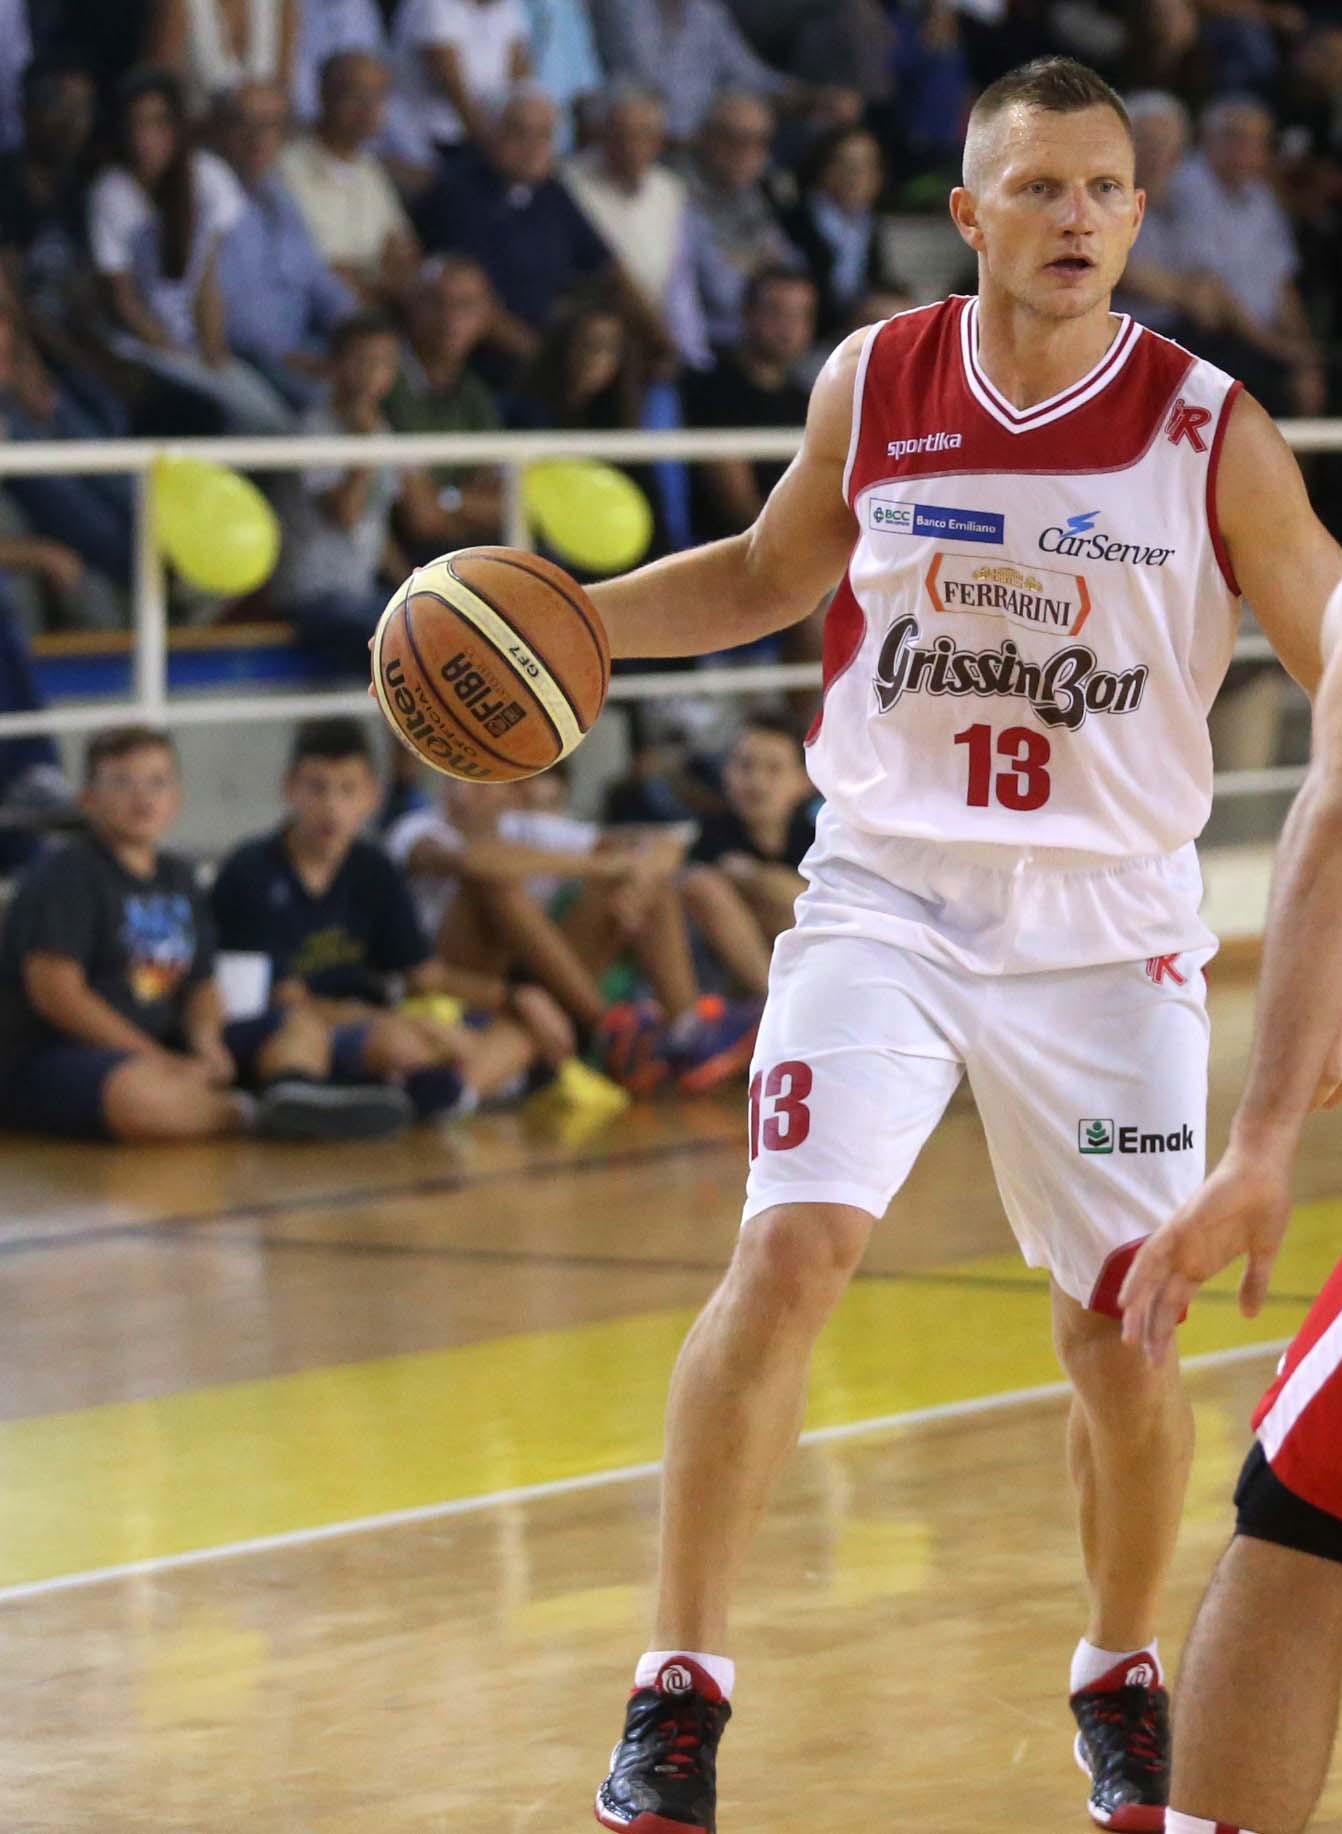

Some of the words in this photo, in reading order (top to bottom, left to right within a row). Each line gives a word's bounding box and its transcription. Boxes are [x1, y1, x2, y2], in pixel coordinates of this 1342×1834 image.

[887, 432, 962, 460] sportika
[885, 509, 910, 521] BCC
[916, 515, 946, 528] Banco
[948, 519, 996, 533] Emiliano
[1038, 527, 1175, 566] CarServer
[944, 581, 1072, 626] FERRARINI
[509, 645, 538, 677] GF7
[873, 613, 1149, 731] GrissinBon
[441, 652, 504, 721] FIBA
[386, 658, 492, 777] molten
[415, 686, 478, 757] OFFICIAL
[954, 723, 1051, 811] 13
[750, 1061, 812, 1160] 13
[1119, 1123, 1193, 1153] Emak
